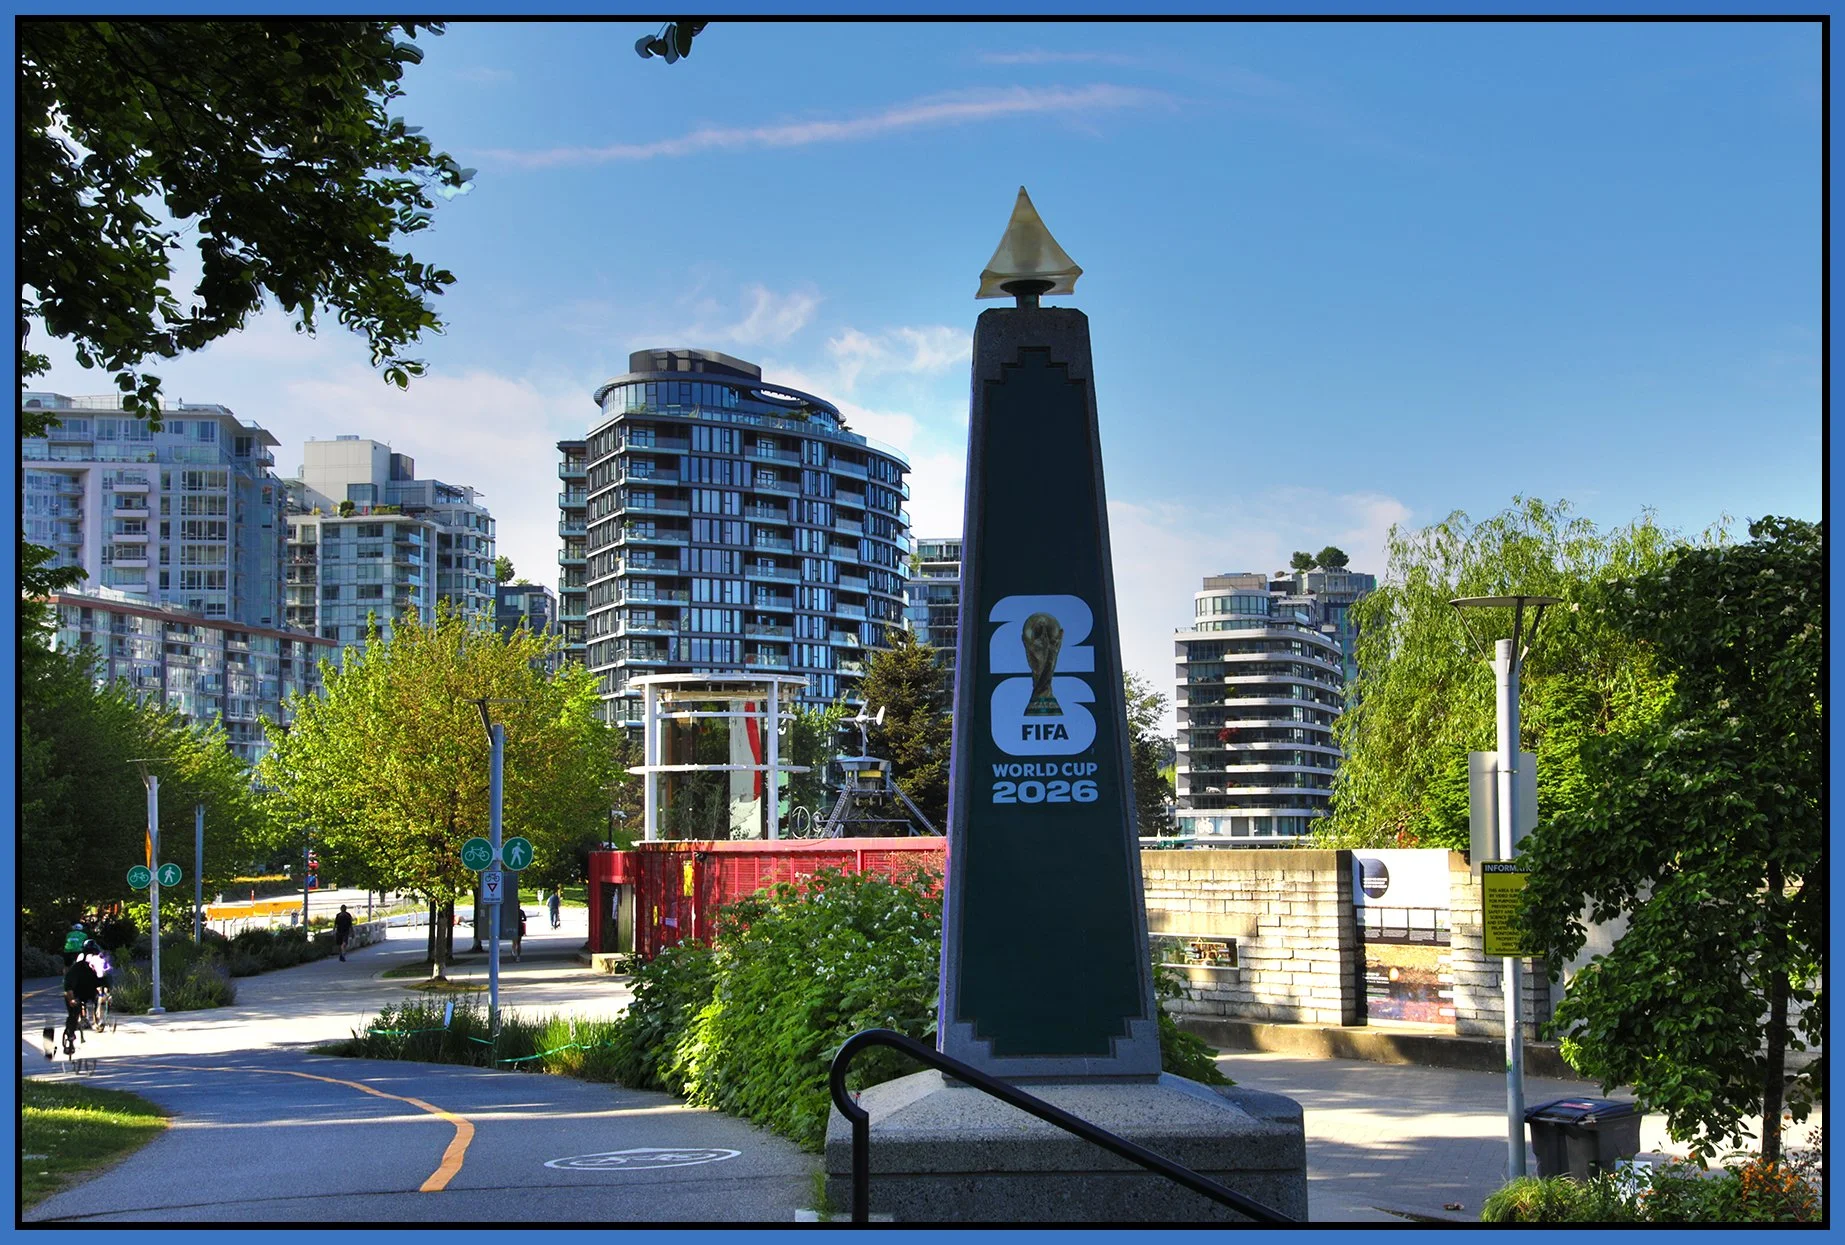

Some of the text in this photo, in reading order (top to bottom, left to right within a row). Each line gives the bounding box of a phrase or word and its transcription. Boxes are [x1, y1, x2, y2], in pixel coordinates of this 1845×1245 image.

[1022, 724, 1069, 741] FIFA
[992, 762, 1098, 777] WORLD CUP
[992, 780, 1098, 804] 2026
